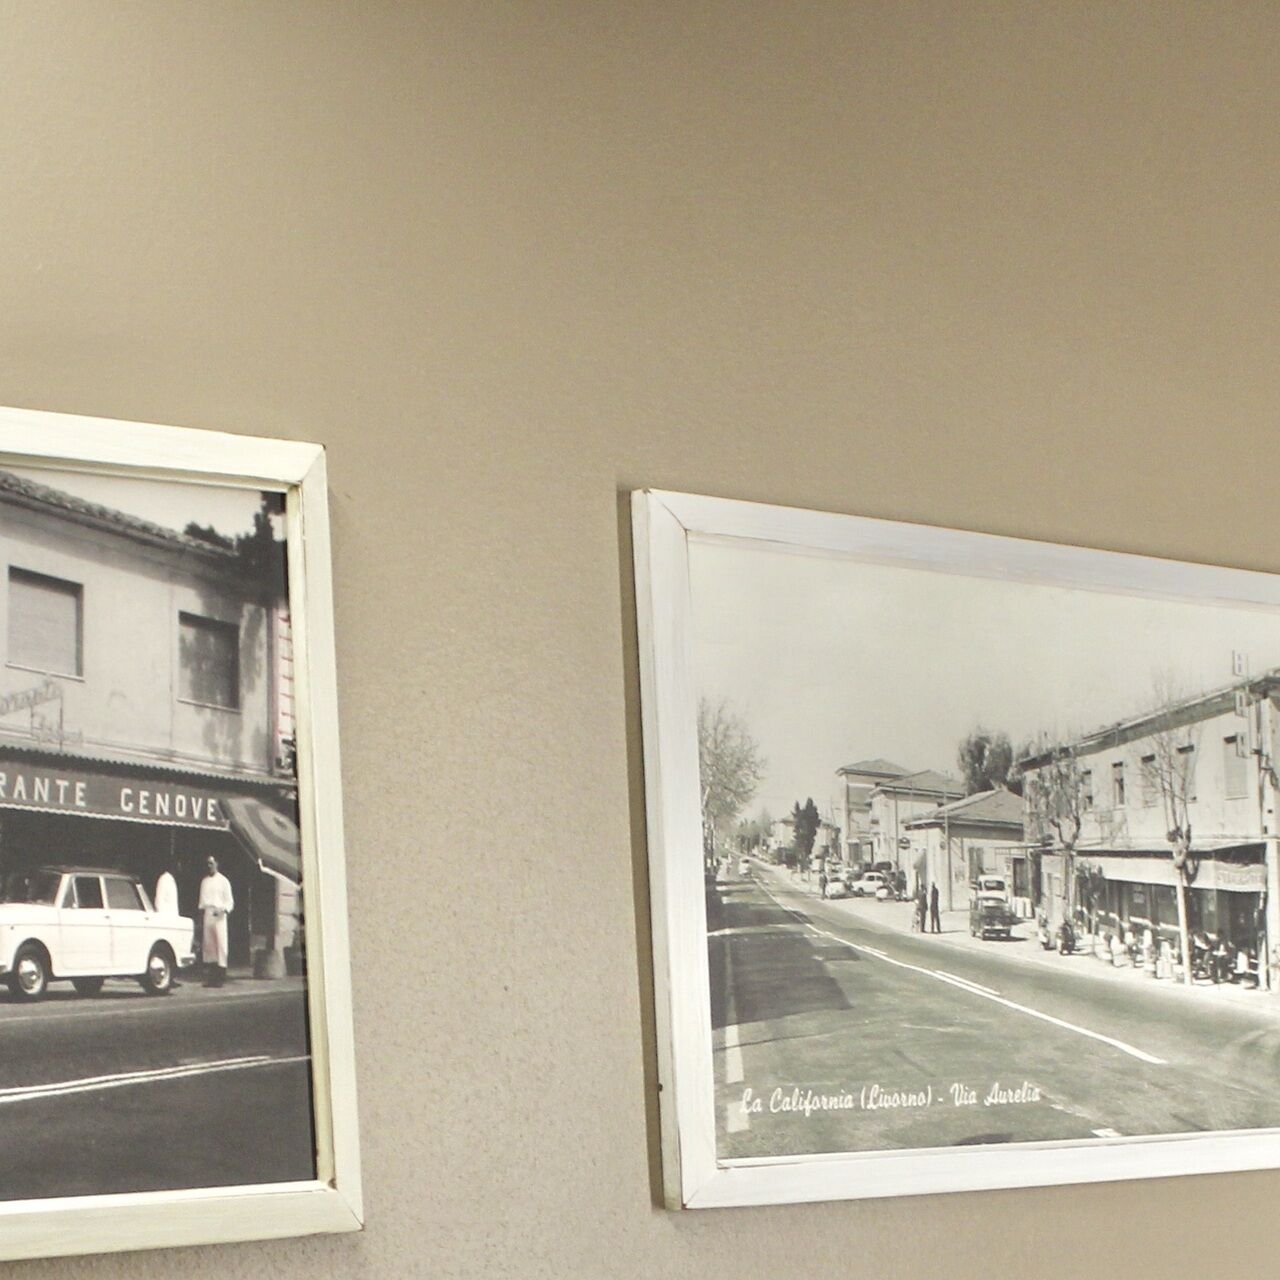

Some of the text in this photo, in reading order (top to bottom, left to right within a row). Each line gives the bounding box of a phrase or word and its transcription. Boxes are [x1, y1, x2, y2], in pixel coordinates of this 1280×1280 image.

[119, 787, 219, 822] GENOVE
[739, 1087, 762, 1114] La
[769, 1087, 853, 1118] California
[860, 1084, 932, 1111] (Livorno)
[950, 1082, 978, 1106] Via
[984, 1080, 1041, 1107] Aurelia
